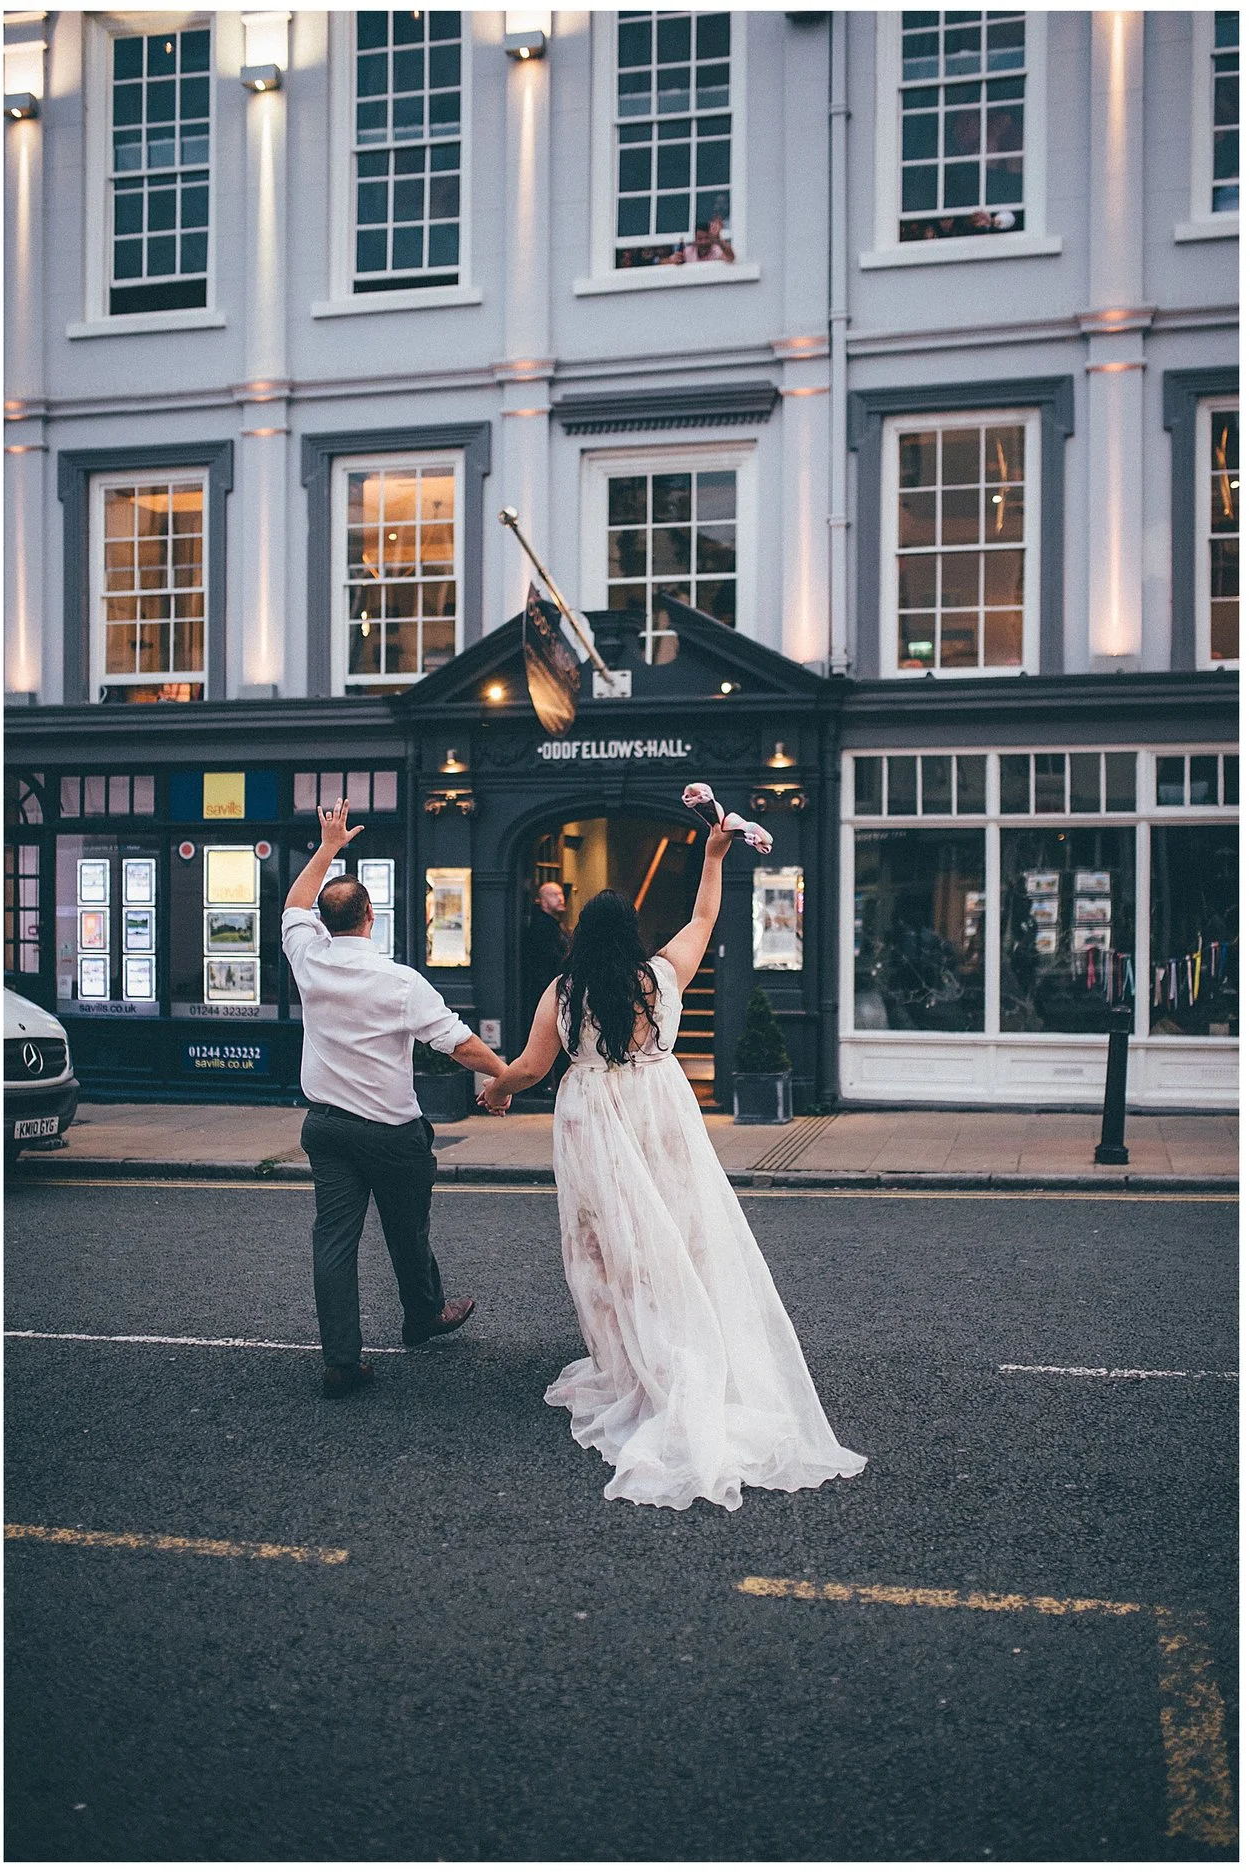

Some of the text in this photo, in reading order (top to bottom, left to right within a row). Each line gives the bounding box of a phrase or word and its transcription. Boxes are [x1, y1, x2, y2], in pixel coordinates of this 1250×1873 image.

[206, 802, 243, 816] savills
[79, 1003, 137, 1014] savills.co.uk
[190, 1006, 260, 1017] 01244 323232
[188, 1046, 261, 1059] 01244 323232
[195, 1058, 254, 1069] savills.co.uk
